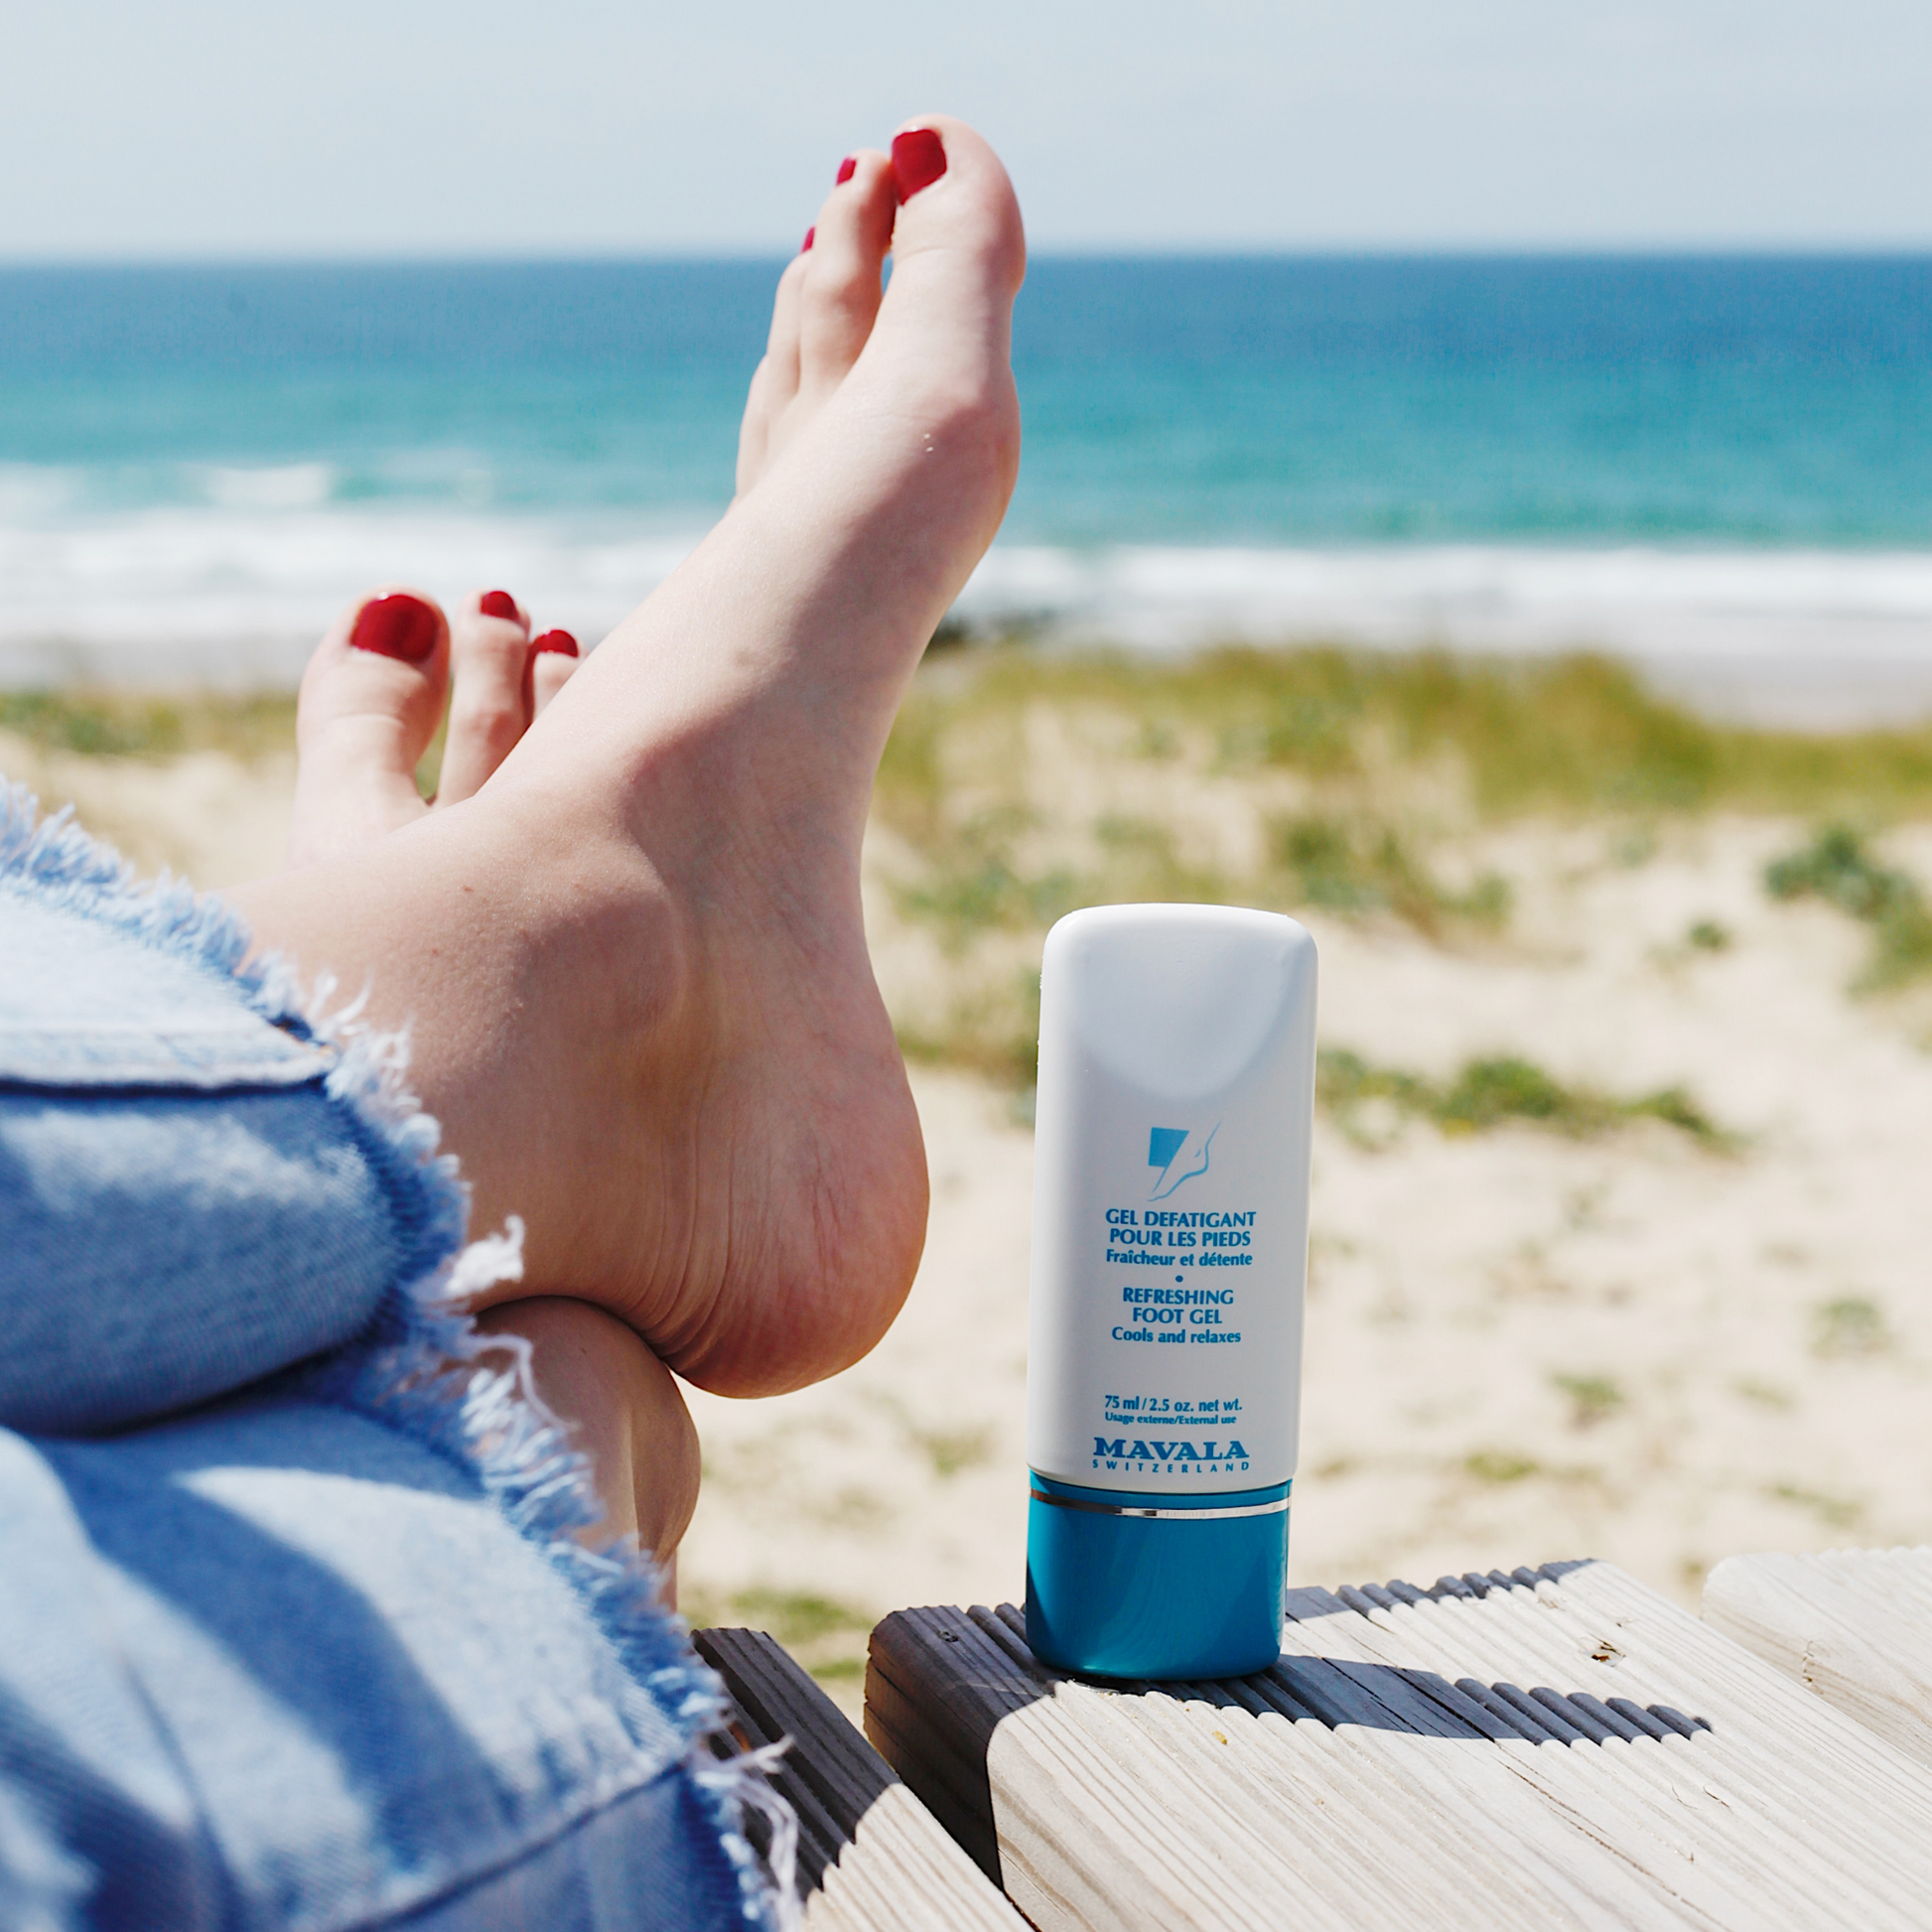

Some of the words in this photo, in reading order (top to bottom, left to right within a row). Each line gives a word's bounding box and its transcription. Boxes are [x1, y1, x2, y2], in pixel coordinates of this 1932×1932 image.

[1105, 1208, 1139, 1225] GEL
[1144, 1210, 1257, 1228] DEFATIGANT
[1109, 1227, 1163, 1246] POUR
[1168, 1231, 1196, 1247] LES
[1202, 1231, 1251, 1247] PIEDS
[1106, 1248, 1175, 1266] Fraîcheur
[1179, 1253, 1194, 1266] et
[1198, 1252, 1253, 1266] détente
[1123, 1287, 1234, 1305] REFRESHING
[1133, 1308, 1184, 1324] FOOT
[1189, 1309, 1223, 1324] GEL
[1111, 1326, 1154, 1342] Cools
[1158, 1328, 1185, 1343] and
[1190, 1329, 1241, 1343] relaxes
[1105, 1394, 1120, 1409] 75
[1173, 1401, 1194, 1412] oz.
[1198, 1399, 1219, 1412] net
[1223, 1398, 1242, 1411] wt.
[1105, 1411, 1135, 1425] Usage
[1221, 1416, 1237, 1425] use
[1093, 1437, 1250, 1460] MAVALA
[1092, 1458, 1250, 1473] SWITZERLAND
